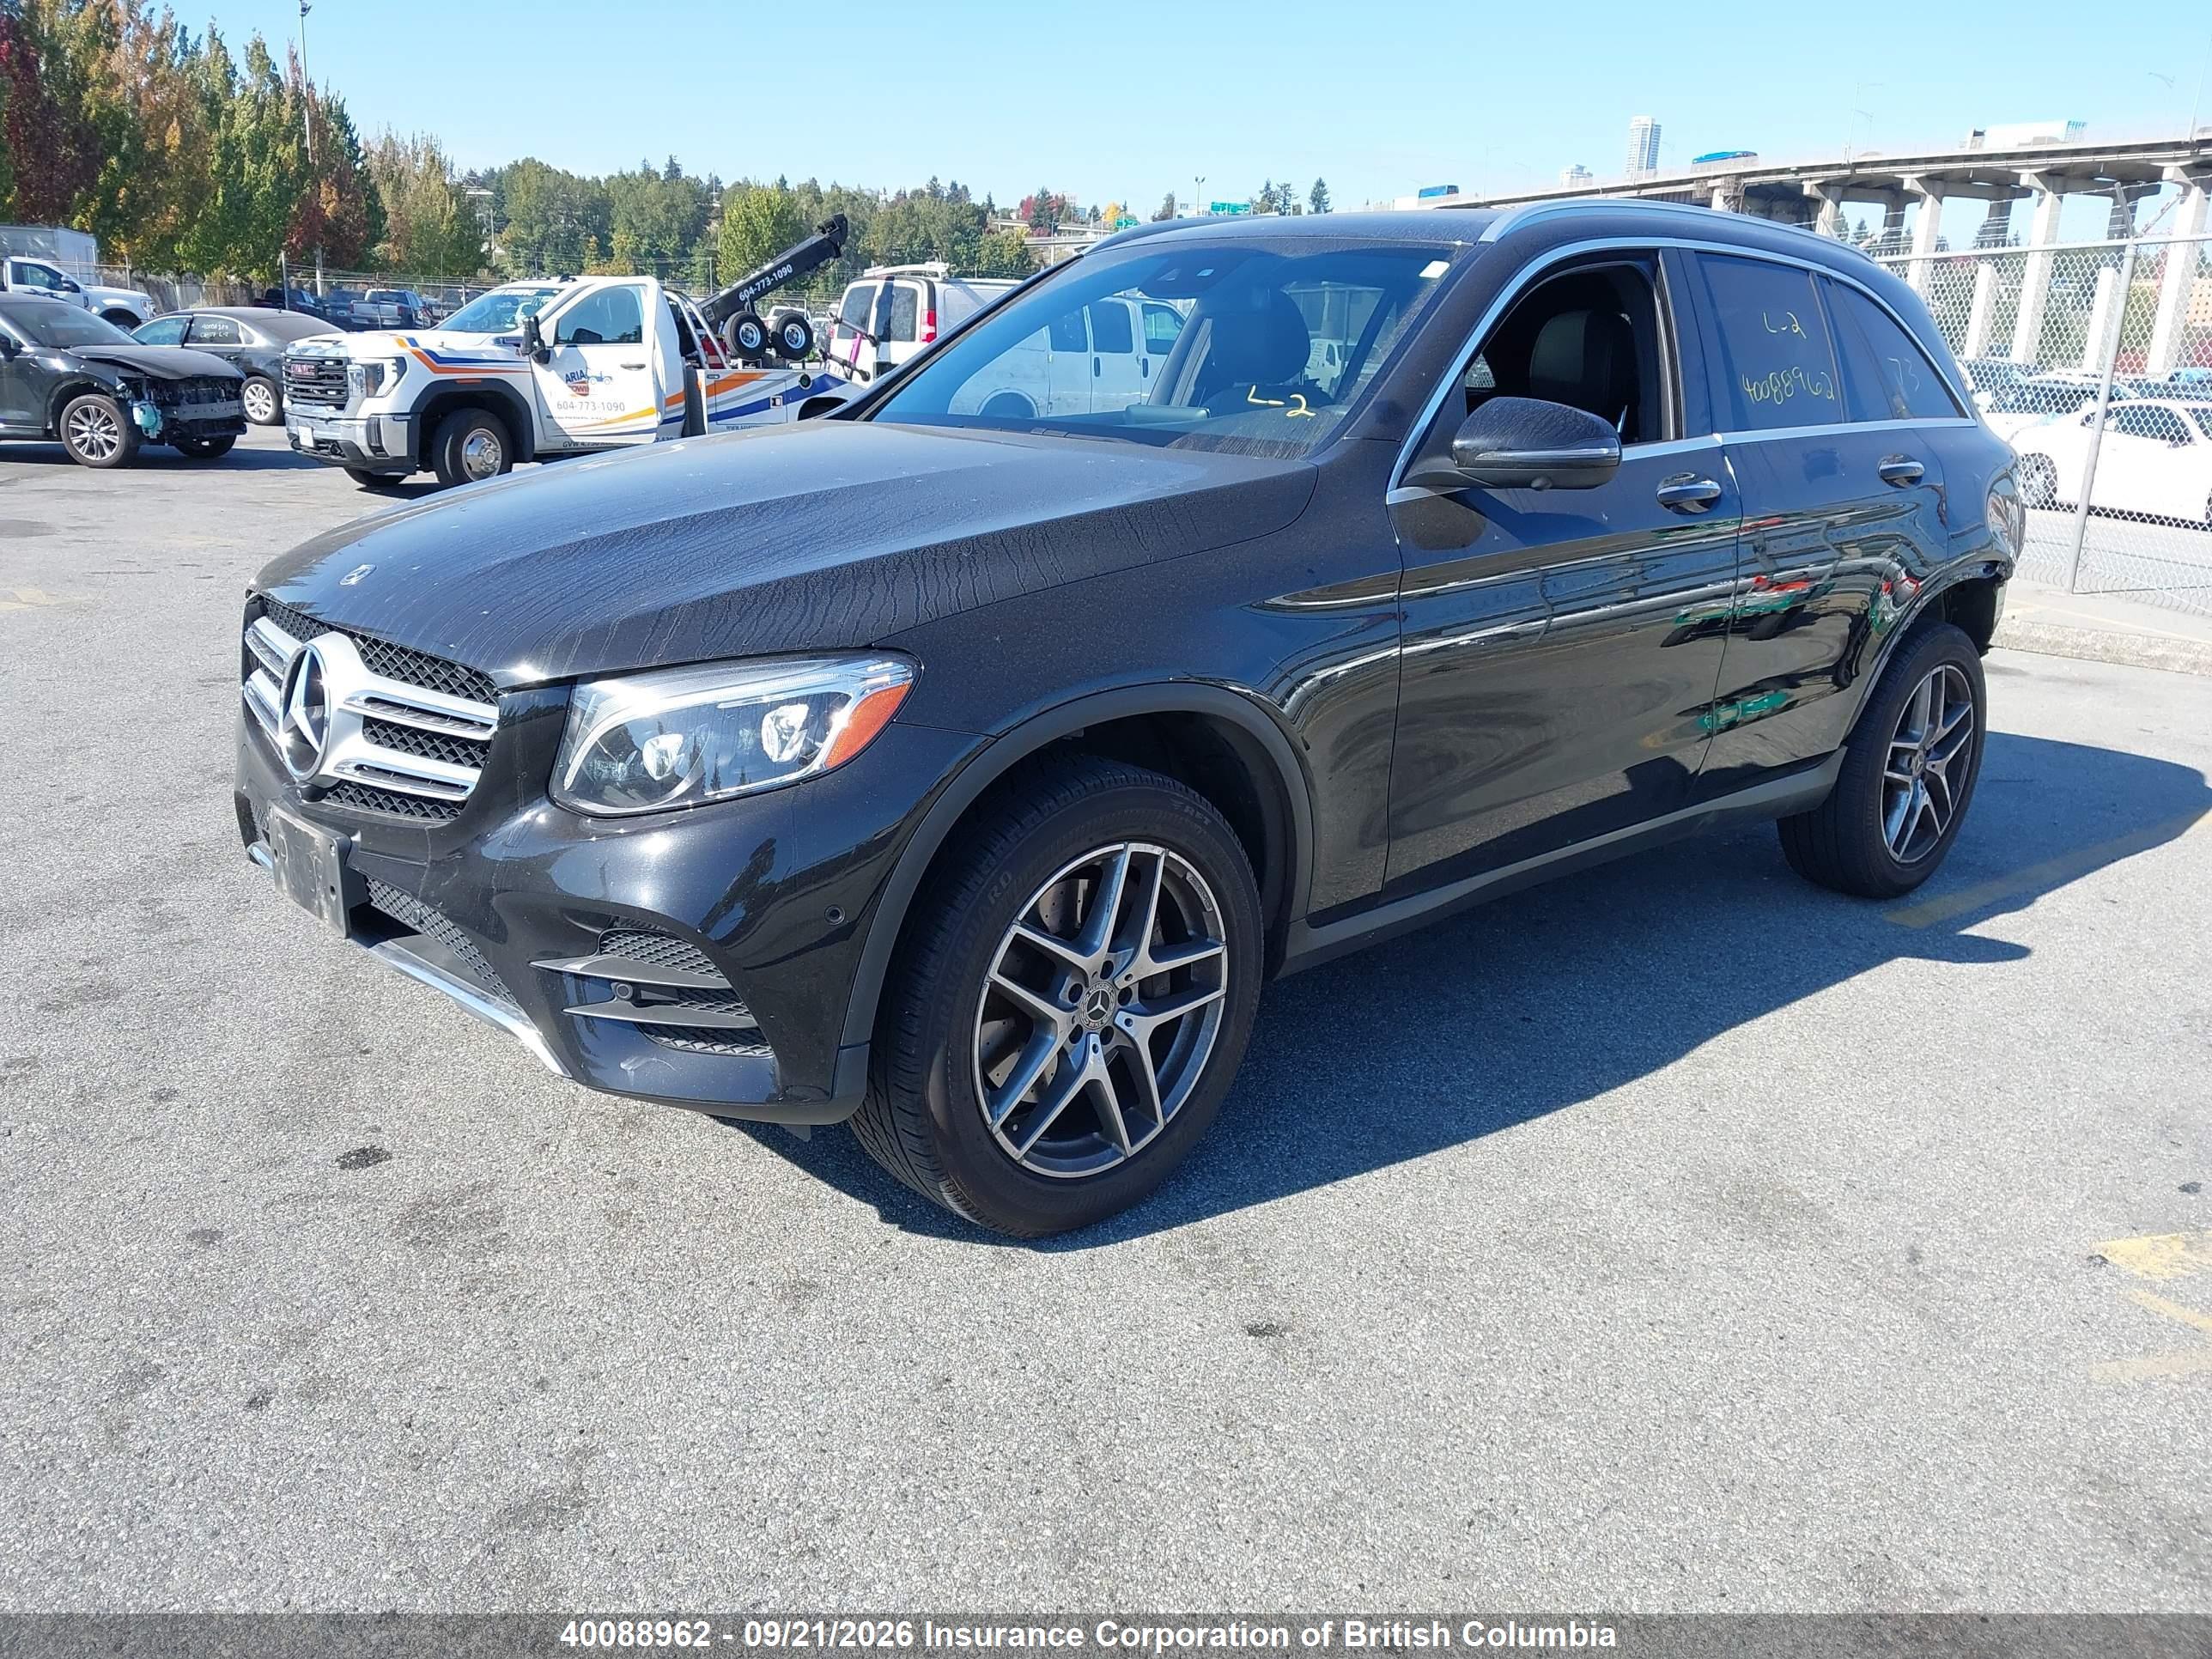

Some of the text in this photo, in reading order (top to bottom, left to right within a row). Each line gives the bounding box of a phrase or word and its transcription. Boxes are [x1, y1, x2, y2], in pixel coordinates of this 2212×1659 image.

[738, 264, 793, 301] 604-773-1090
[1763, 311, 1808, 339] L-2
[565, 369, 586, 384] ARIA
[1741, 366, 1835, 405] 40088962
[1247, 384, 1317, 417] L-2
